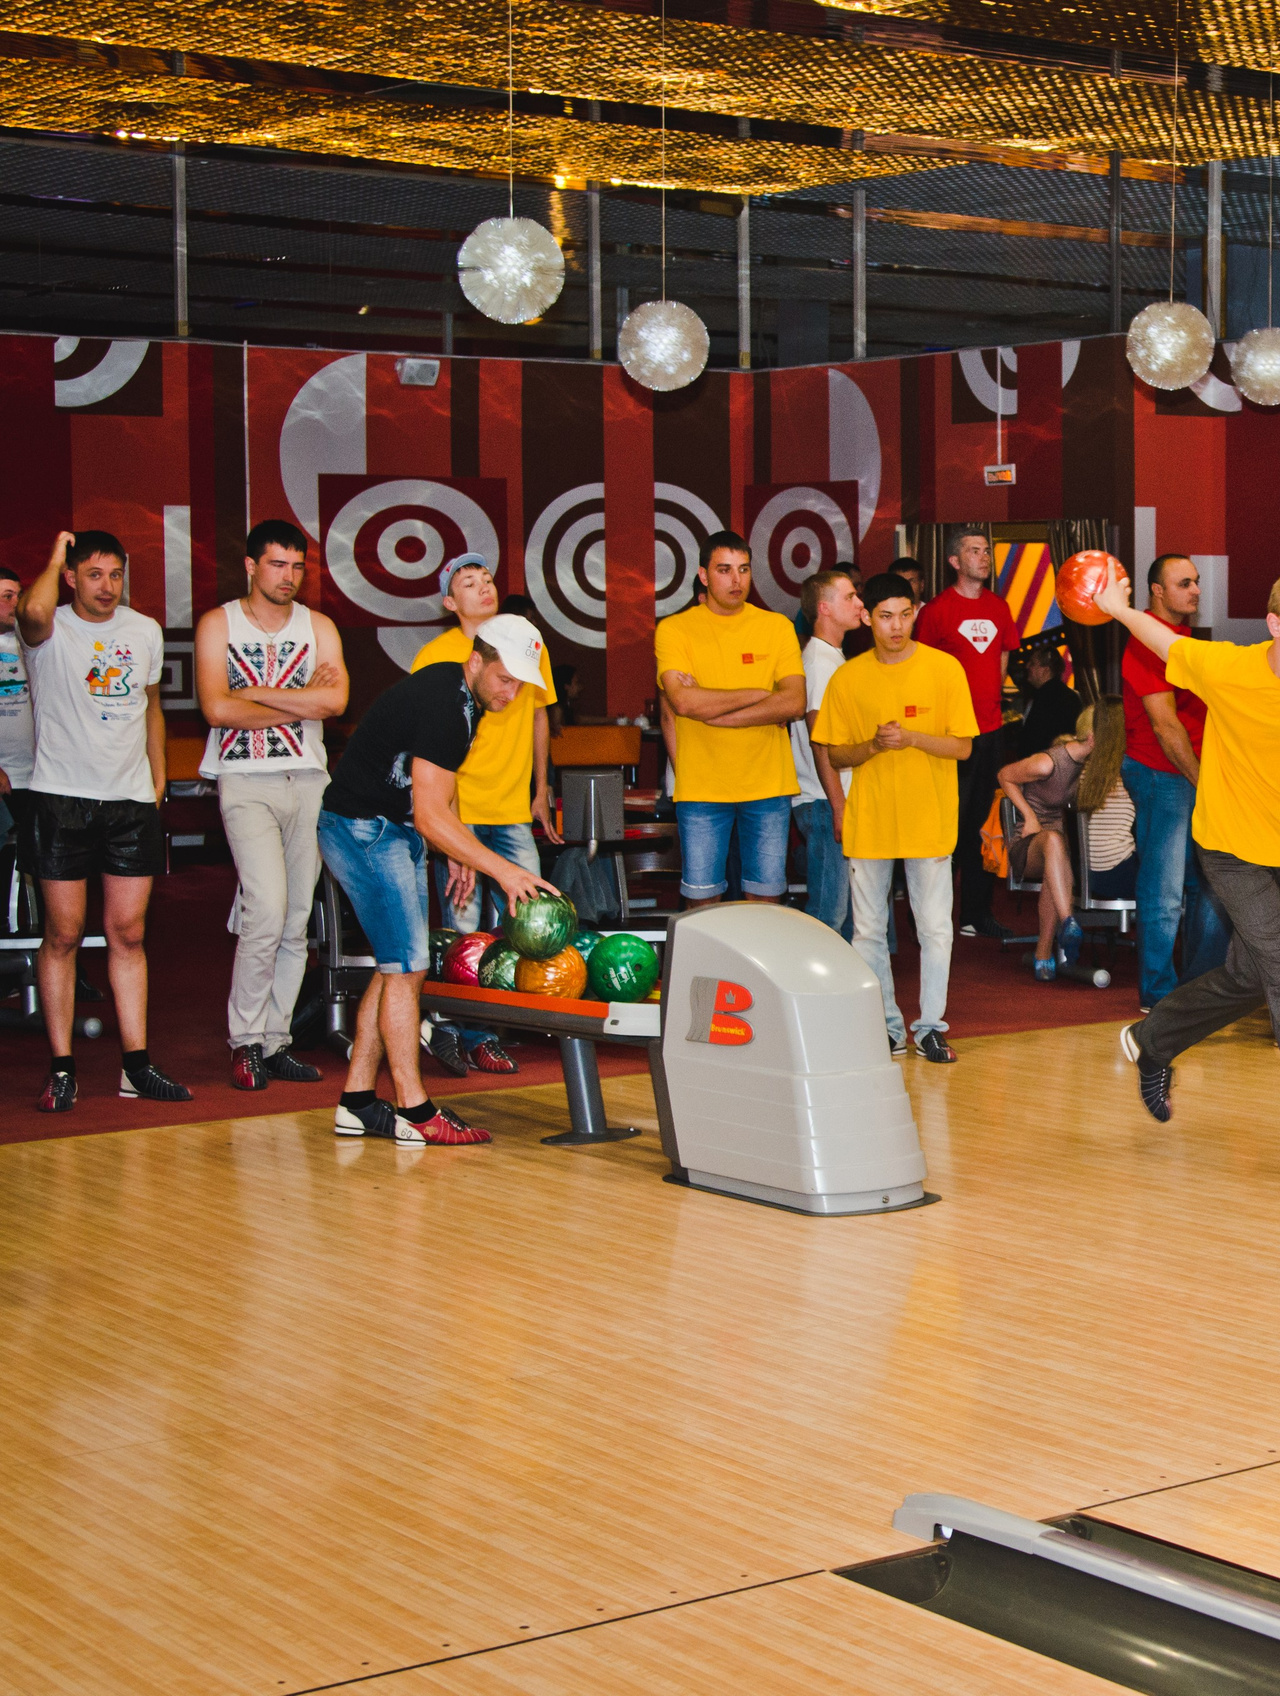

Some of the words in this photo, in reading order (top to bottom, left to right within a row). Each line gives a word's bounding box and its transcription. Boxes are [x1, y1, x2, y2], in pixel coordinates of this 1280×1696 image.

[970, 621, 988, 634] 4G
[710, 1023, 746, 1036] Brunswick
[400, 1127, 413, 1139] 60
